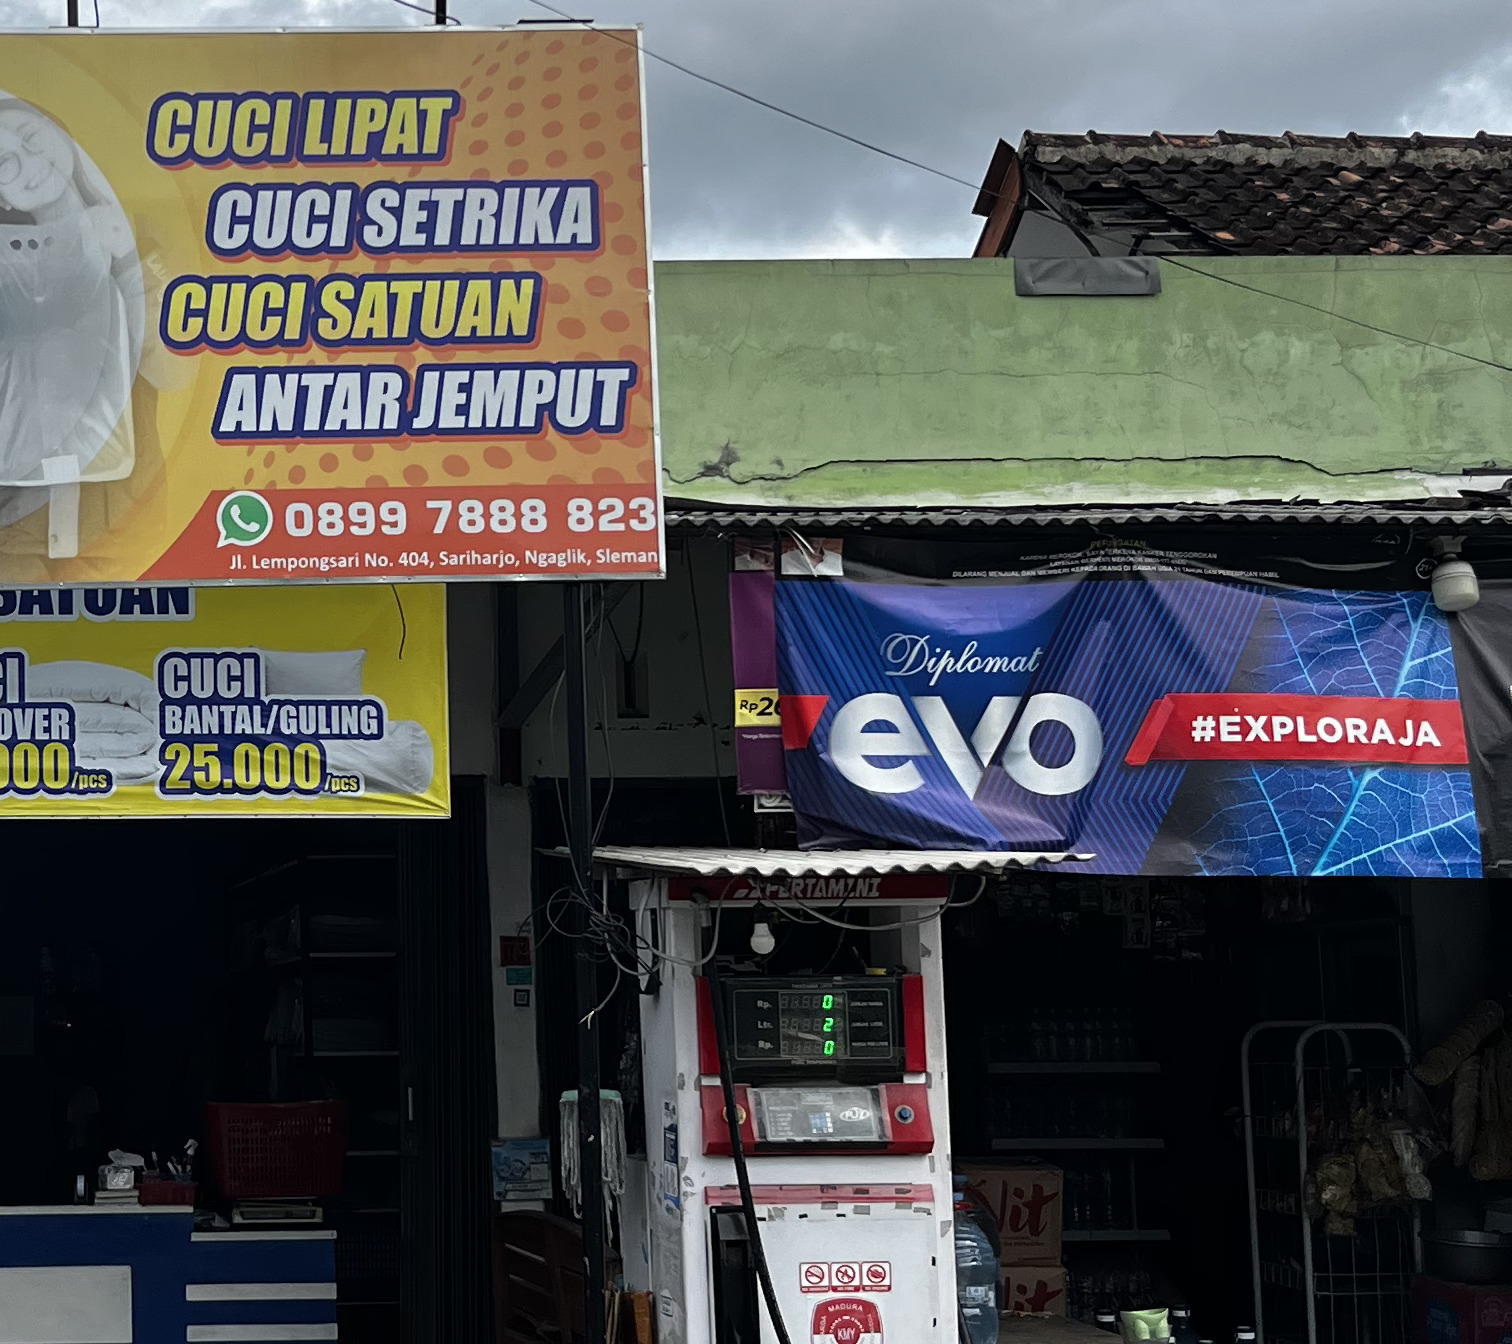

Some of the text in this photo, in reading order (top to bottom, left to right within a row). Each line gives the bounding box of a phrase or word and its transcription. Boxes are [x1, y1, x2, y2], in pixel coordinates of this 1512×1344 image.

[154, 96, 453, 158] CUCI LIPAT
[213, 185, 593, 249] CUCI SETRIKA
[167, 278, 536, 342] CUCI SATUAN
[218, 367, 635, 434] ANTAR JEMPUT
[284, 495, 656, 537] 0899 7888 823
[230, 548, 659, 574] Jl. Lempongsari No. 404, Sariharjo, Ngaglik, Sleman
[162, 656, 258, 700] CUCI
[879, 631, 1044, 686] Diplomat
[164, 703, 381, 737] BANTAL/GULING
[1191, 714, 1442, 747] #EXPLORAJA
[827, 692, 1104, 800] evo
[823, 1017, 834, 1032] 2
[827, 1302, 864, 1313] MADURA
